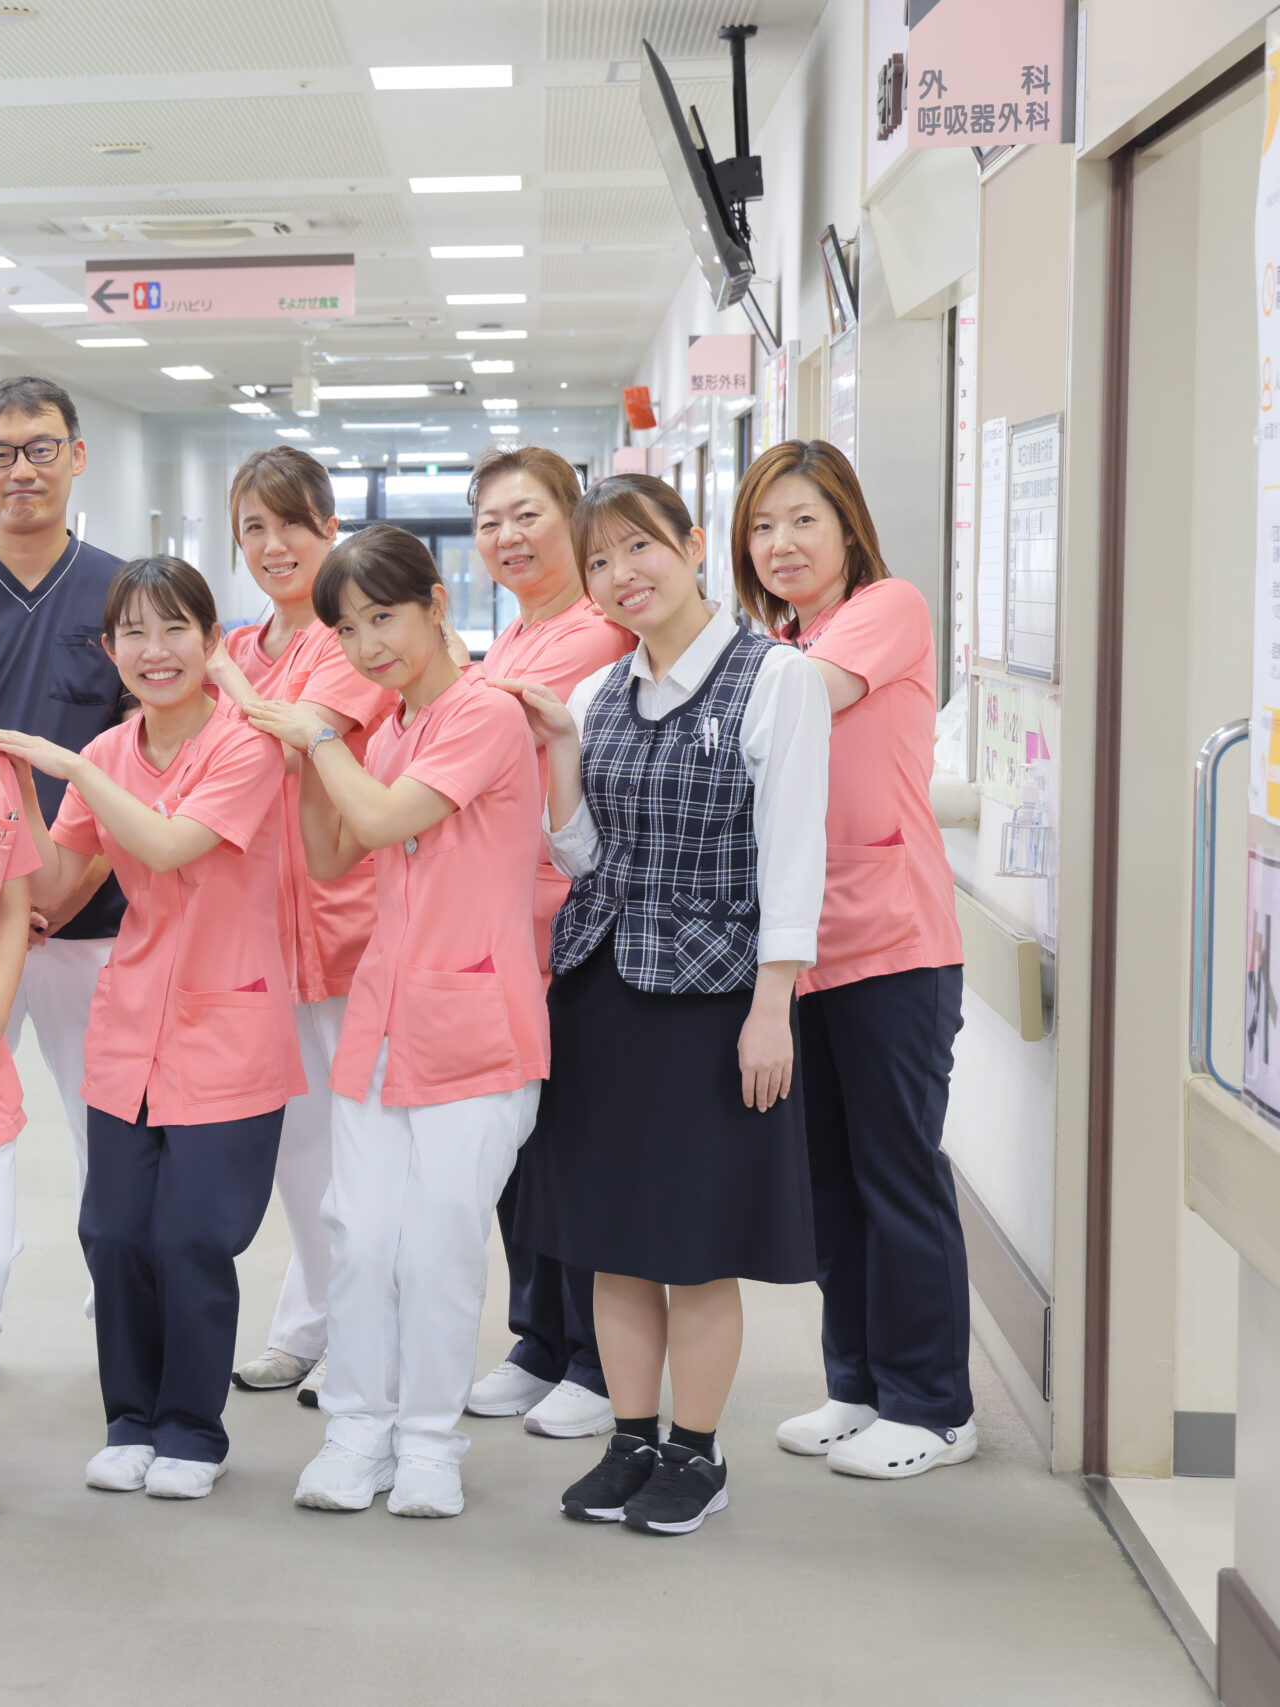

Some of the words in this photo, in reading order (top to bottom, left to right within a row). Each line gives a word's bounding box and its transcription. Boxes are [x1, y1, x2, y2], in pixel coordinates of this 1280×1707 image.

[917, 100, 1050, 136] 呼吸器外科
[163, 298, 213, 313] リハビリ
[691, 373, 746, 390] 整形外科
